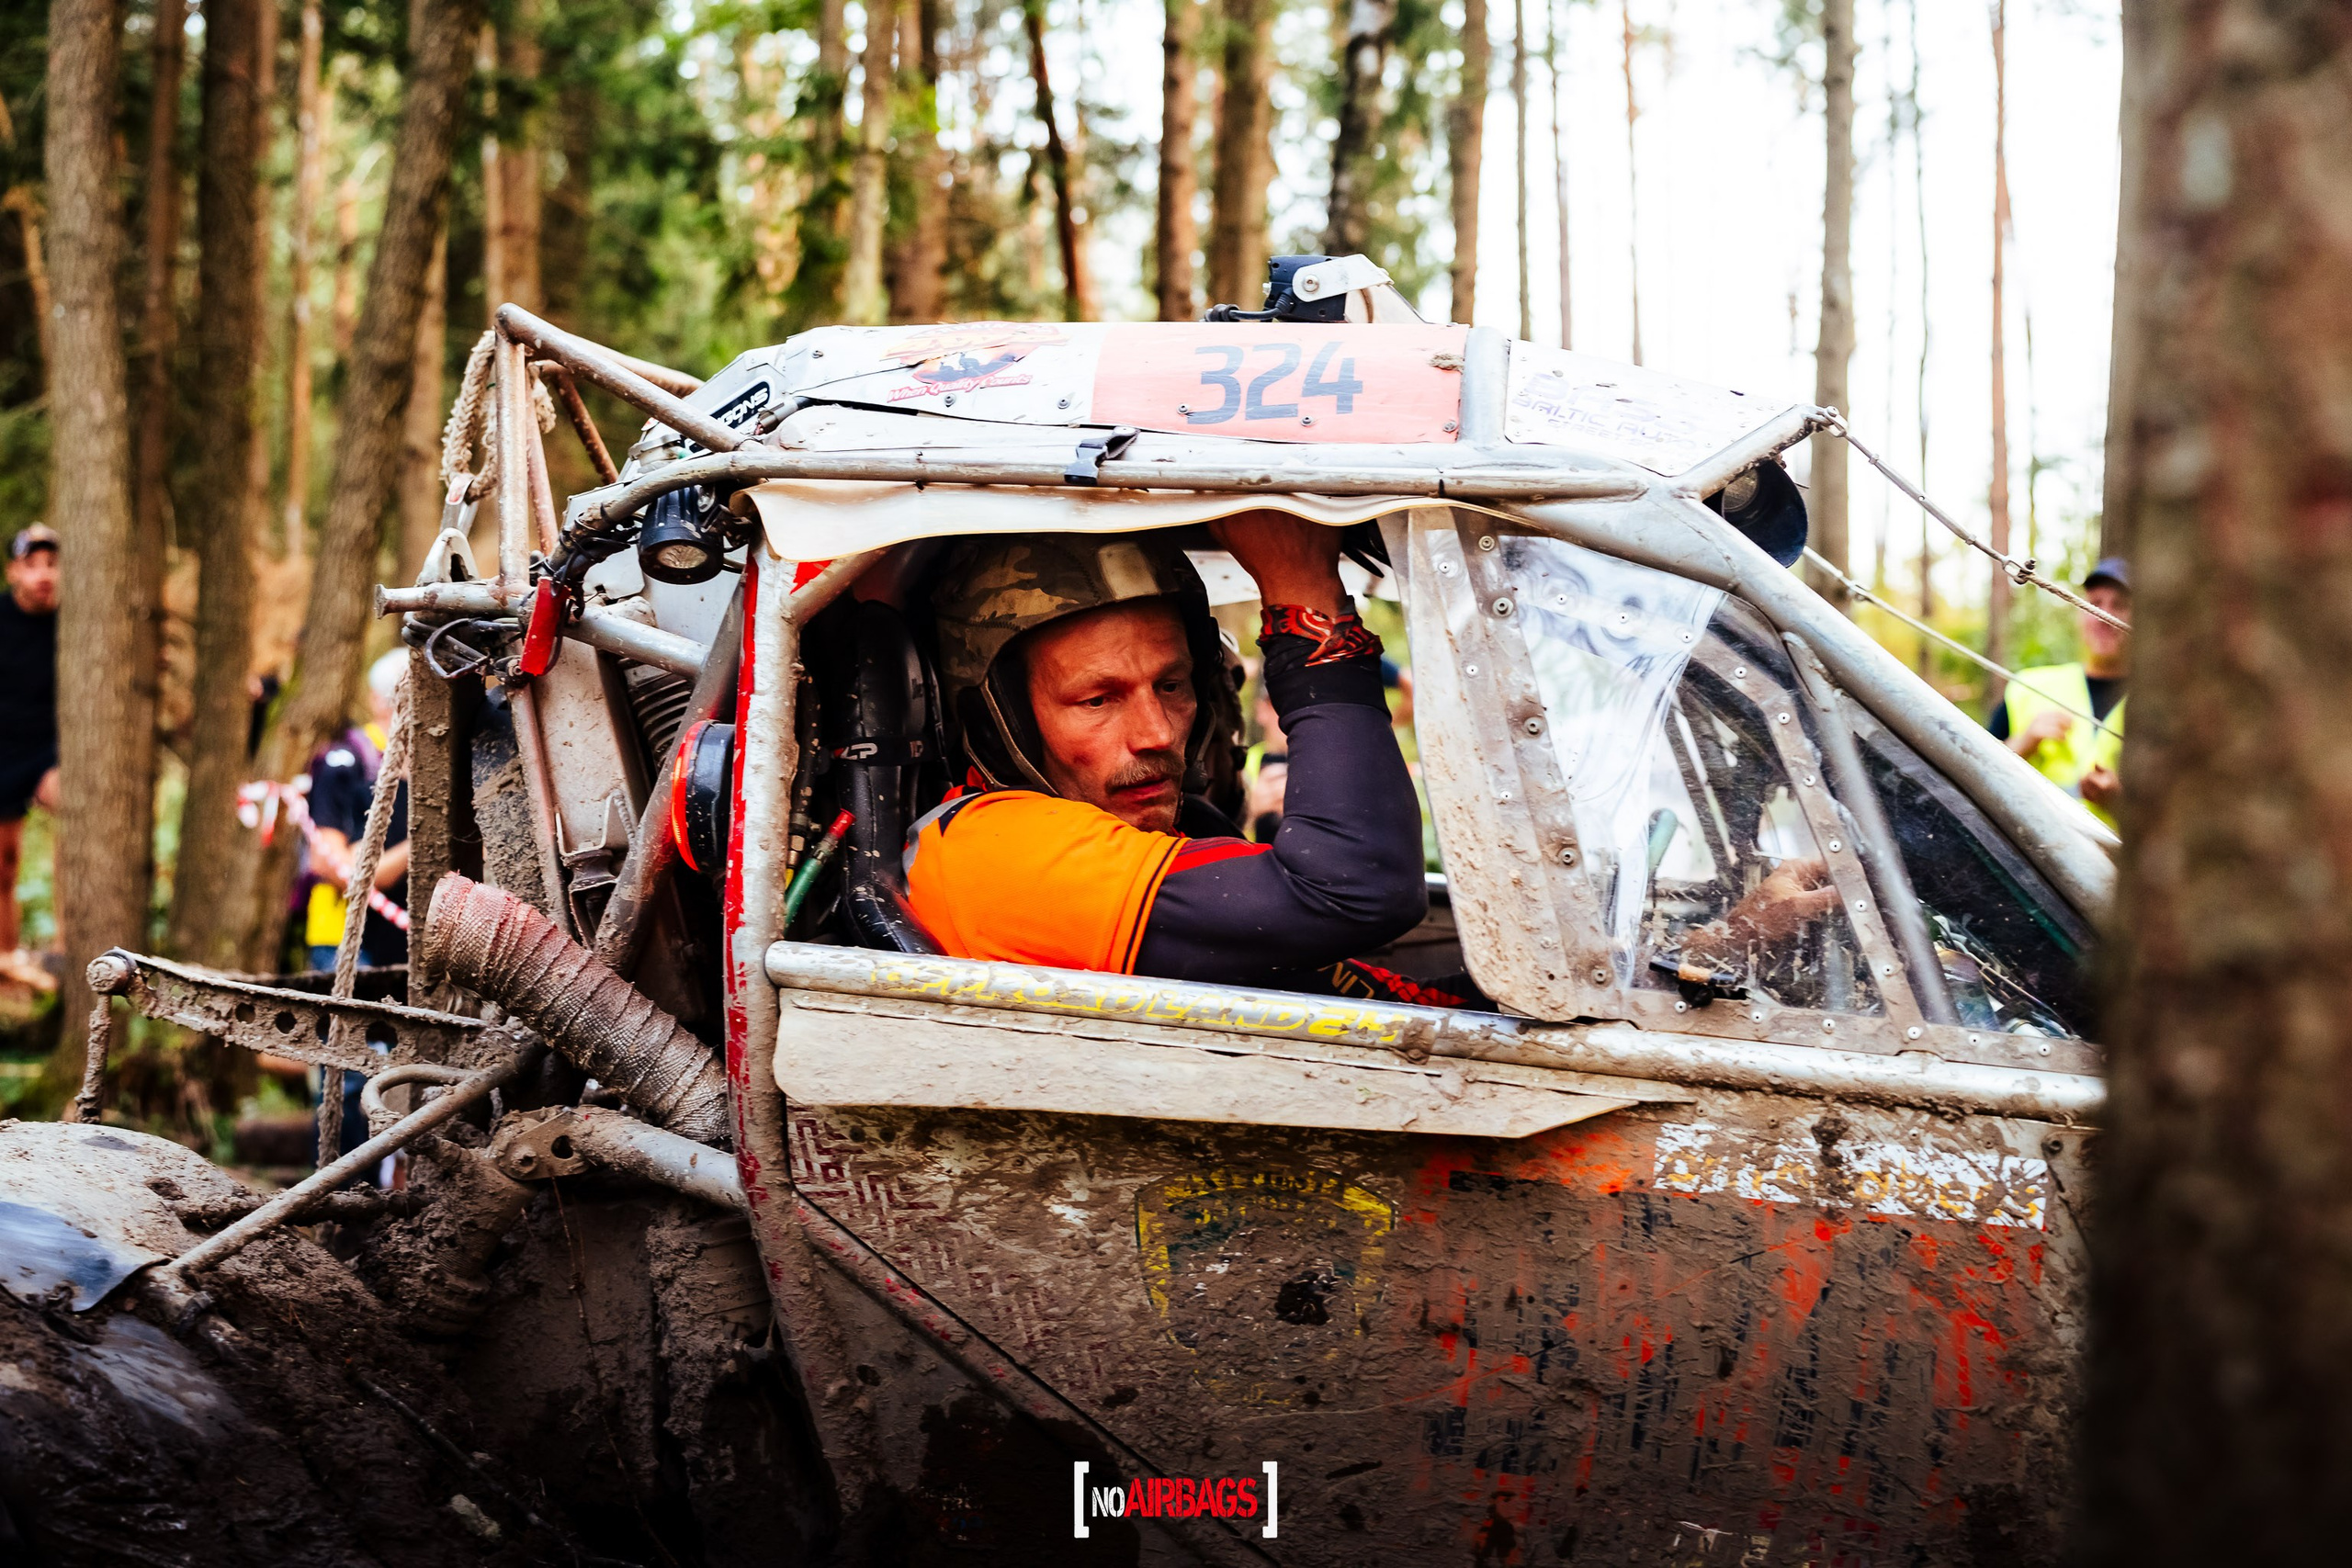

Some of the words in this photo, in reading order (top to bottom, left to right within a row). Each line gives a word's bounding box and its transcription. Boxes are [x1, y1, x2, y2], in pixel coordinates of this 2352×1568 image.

[887, 386, 927, 402] When
[930, 377, 979, 396] Quality
[981, 374, 1033, 390] Counts
[1188, 341, 1363, 424] 324
[1512, 396, 1611, 427] BALTIC
